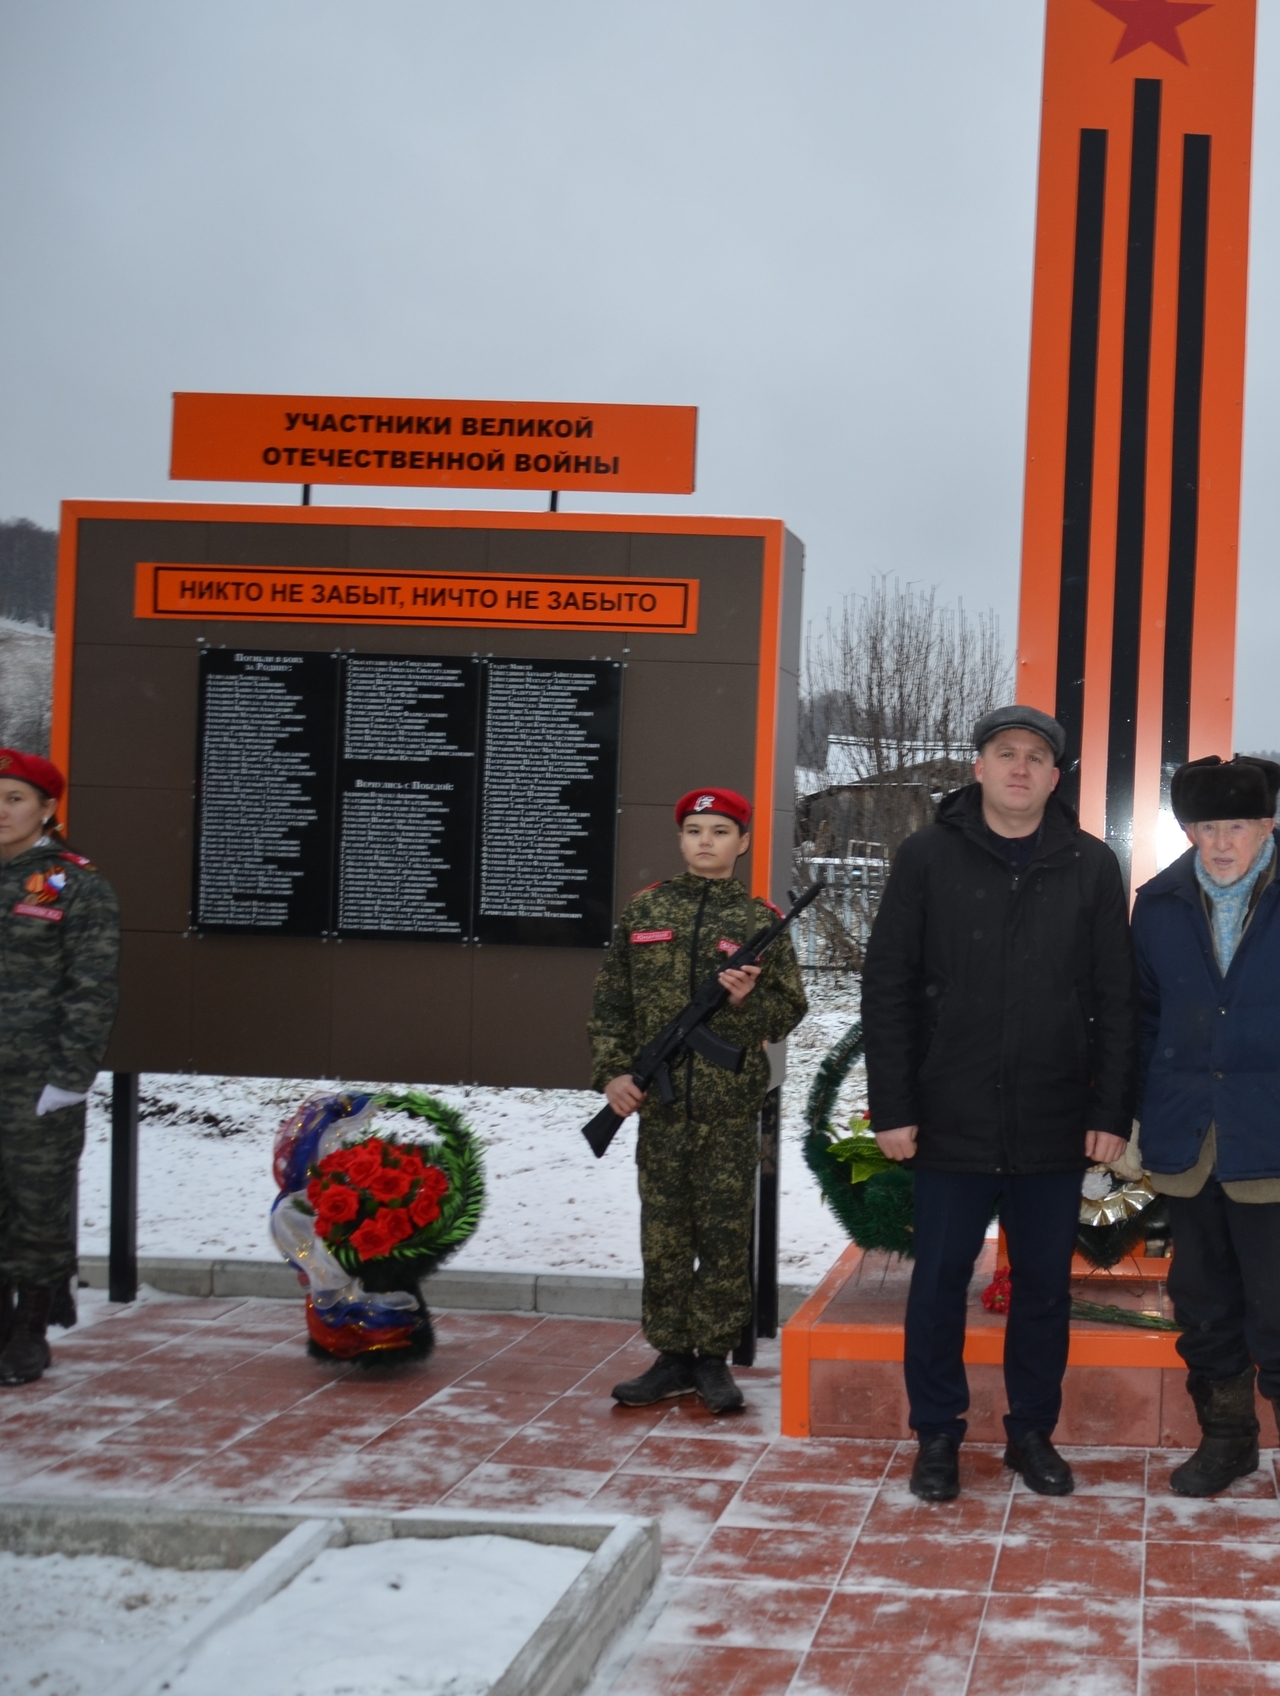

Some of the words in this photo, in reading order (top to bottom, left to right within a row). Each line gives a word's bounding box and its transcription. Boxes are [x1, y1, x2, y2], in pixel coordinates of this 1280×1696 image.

[285, 412, 452, 436] УЧАСТНИКИ
[461, 416, 593, 439] ВЕЛИКОЙ
[262, 446, 505, 472] ОТЕЧЕСТВЕННОЙ
[514, 451, 619, 475] ВОЙНЫ
[180, 580, 263, 602] НИКТО
[271, 583, 303, 603] НЕ
[311, 584, 405, 610] ЗАБЫТ,
[413, 587, 498, 609] НИЧТО
[506, 590, 539, 610] НЕ
[548, 590, 657, 613] ЗАБЫТО
